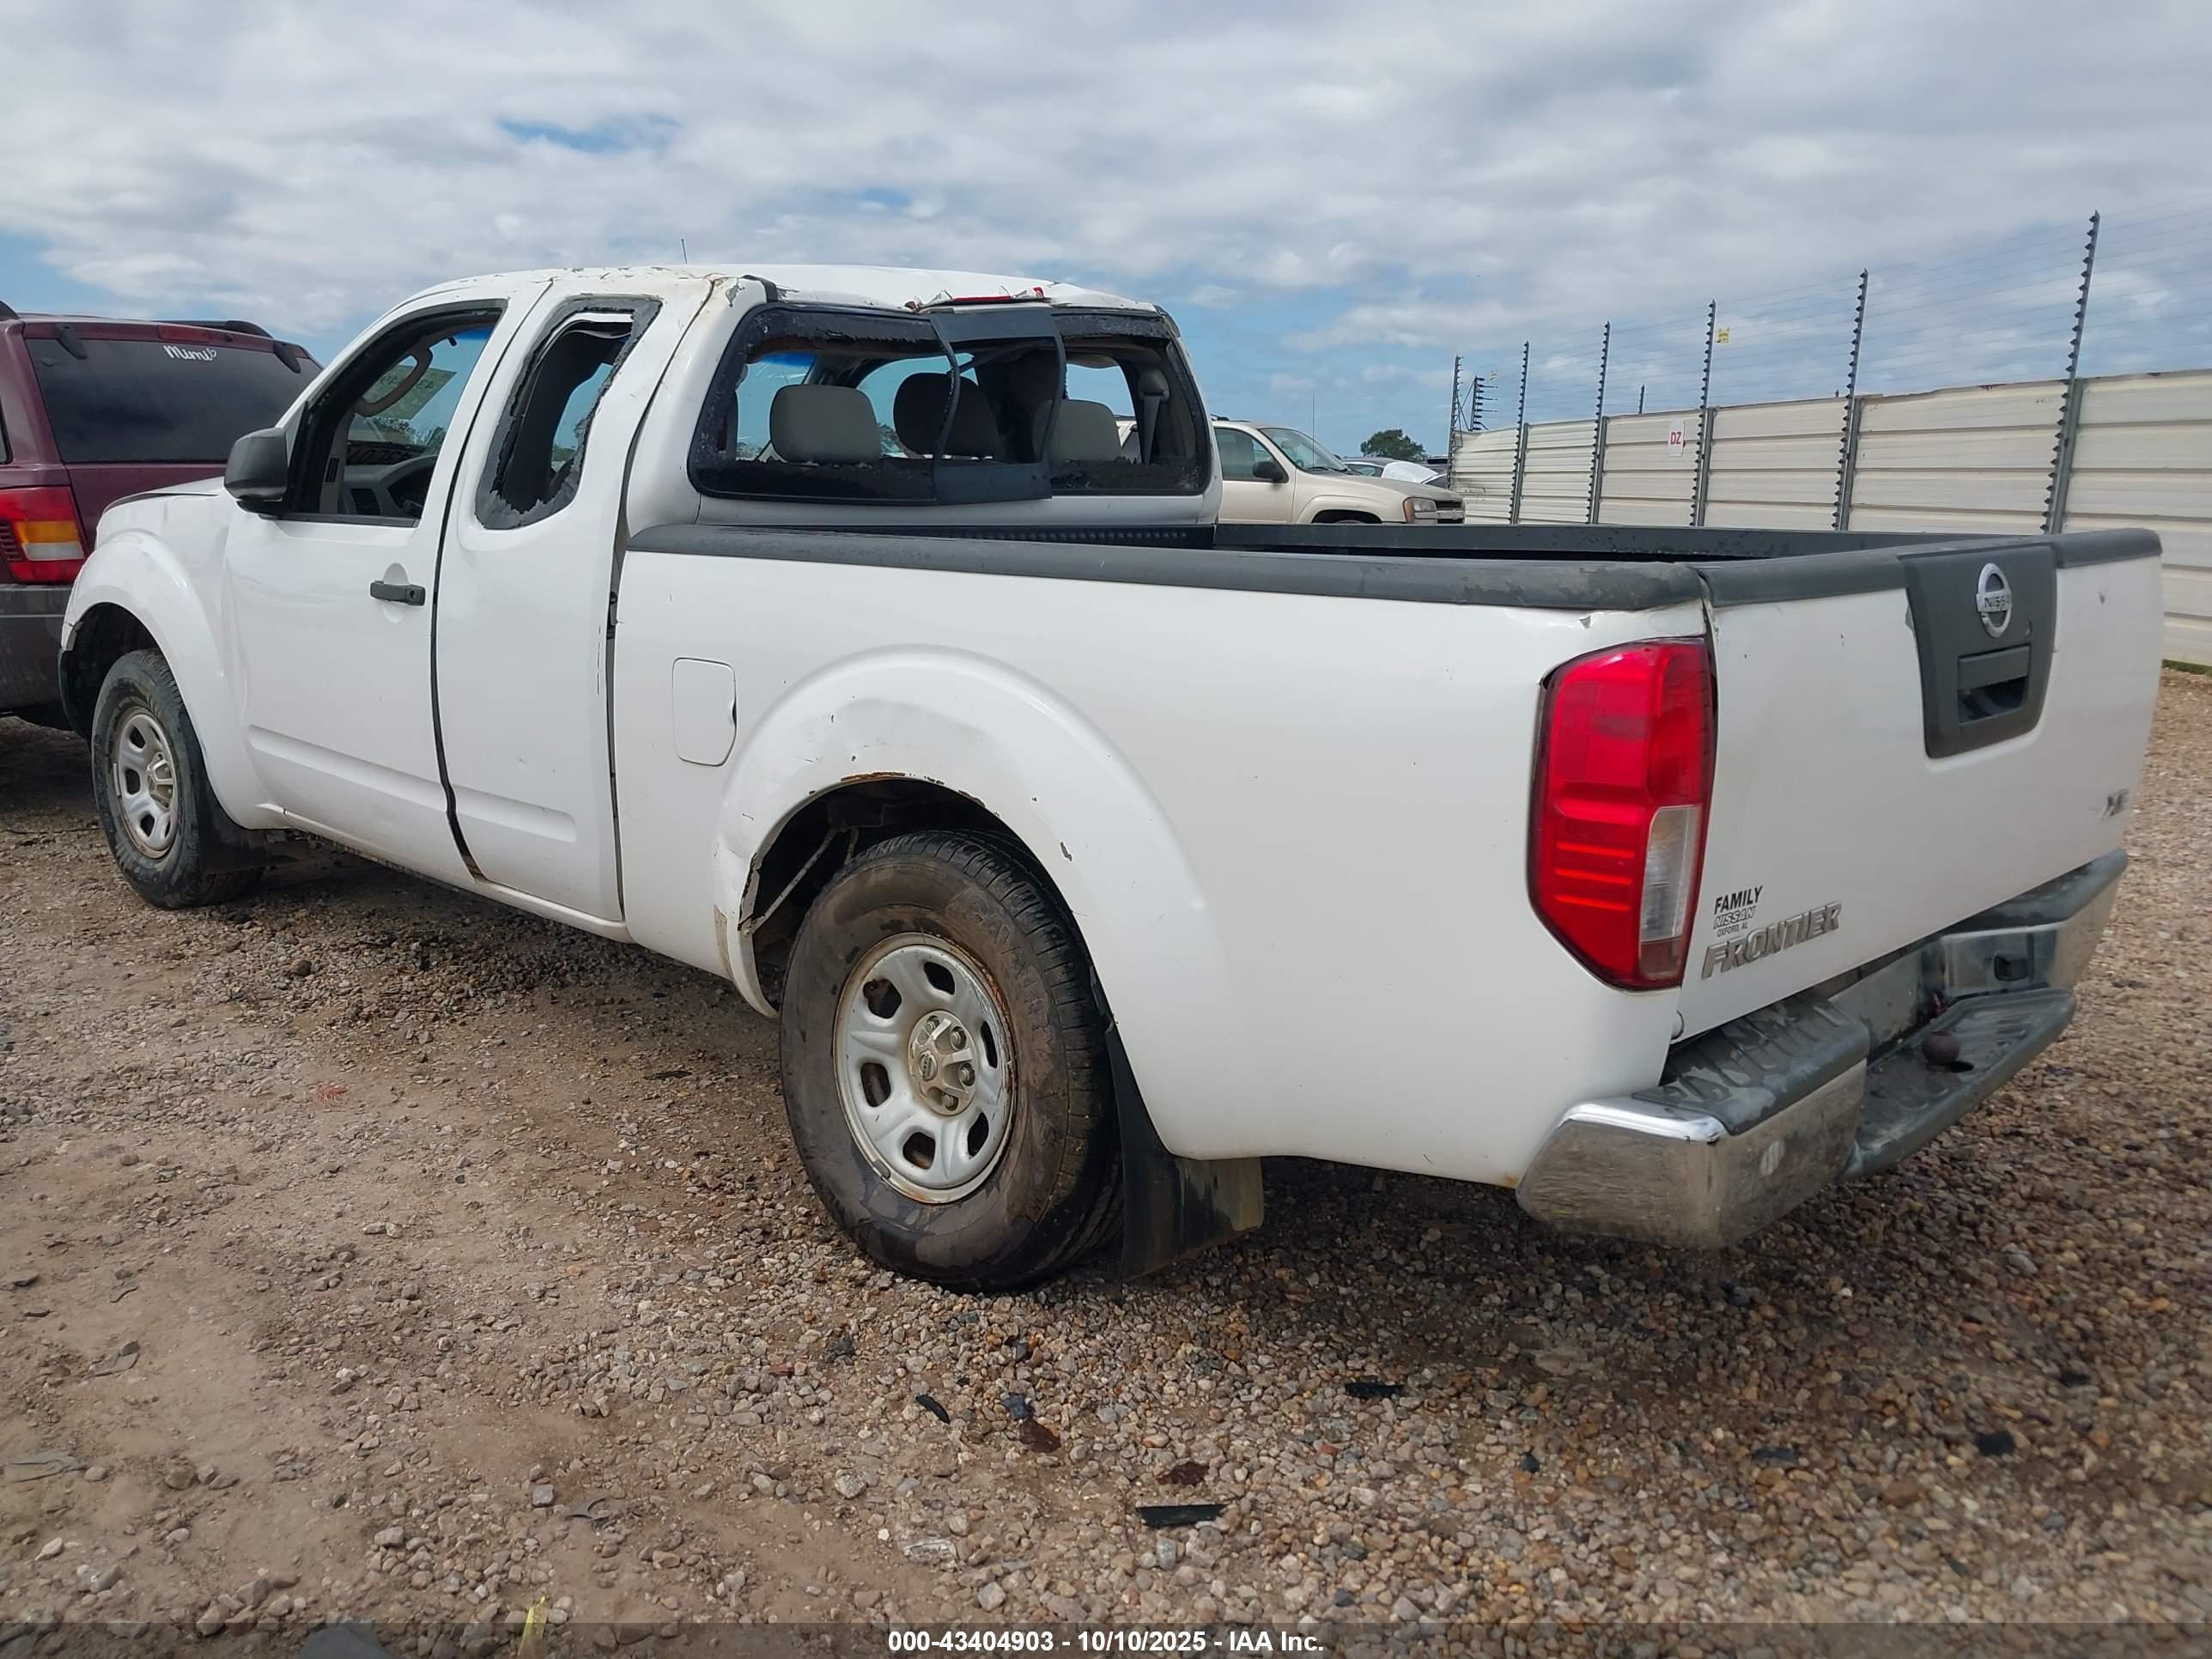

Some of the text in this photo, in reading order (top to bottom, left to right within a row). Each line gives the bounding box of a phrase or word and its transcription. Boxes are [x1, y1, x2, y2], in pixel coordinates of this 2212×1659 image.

[163, 345, 213, 361] Mimi
[1670, 431, 1682, 445] DZ
[1713, 885, 1763, 915] FAMILY
[1713, 906, 1756, 929] NISSAN
[1701, 902, 1842, 980] FRONTIER
